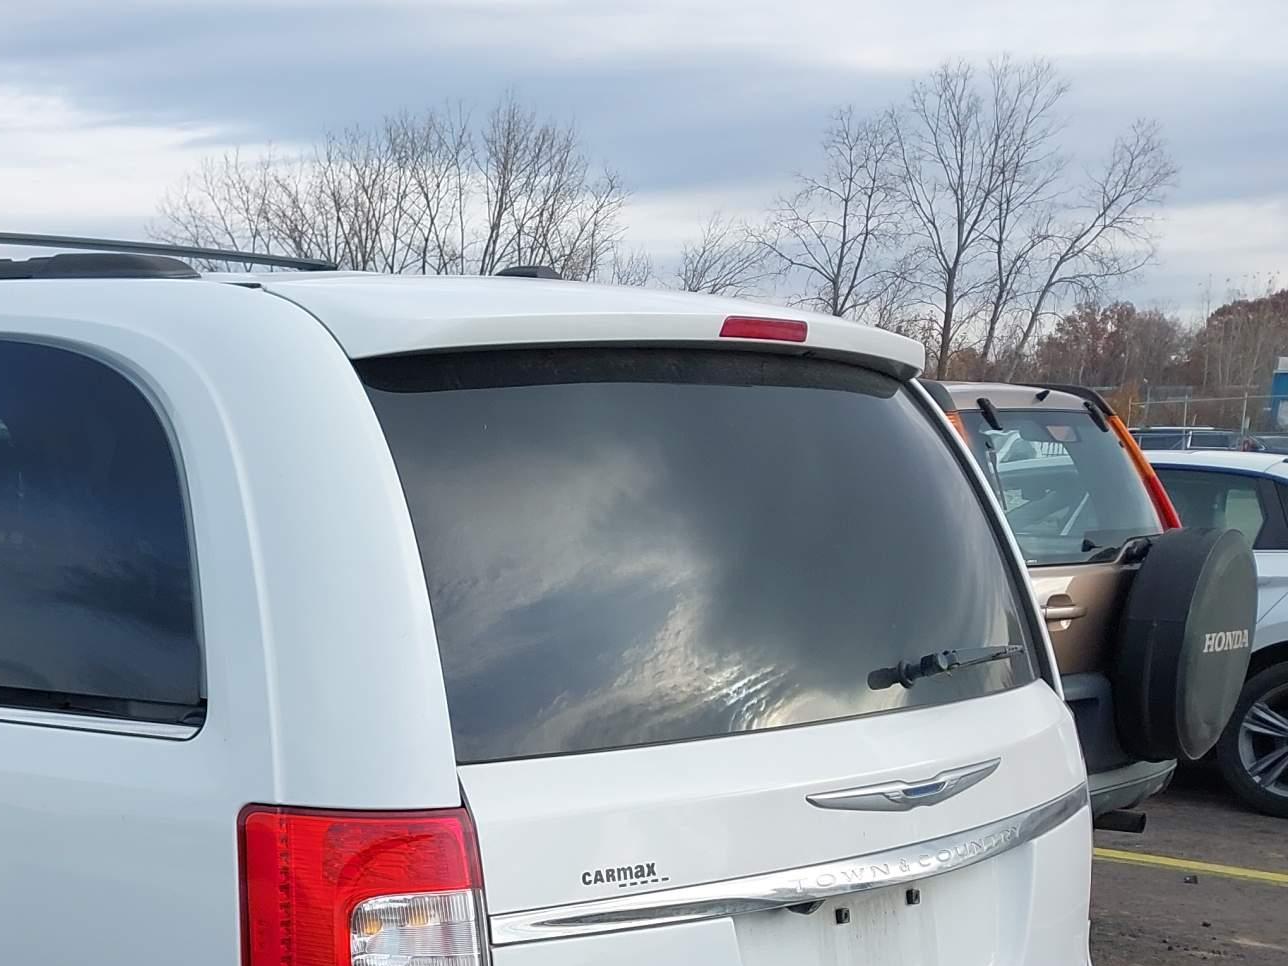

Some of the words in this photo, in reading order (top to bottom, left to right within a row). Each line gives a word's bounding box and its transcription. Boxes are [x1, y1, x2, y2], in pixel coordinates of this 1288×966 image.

[1203, 629, 1248, 653] HONDA
[789, 863, 889, 893] TOWN
[899, 857, 911, 873] &
[918, 824, 1020, 868] COUNTRY
